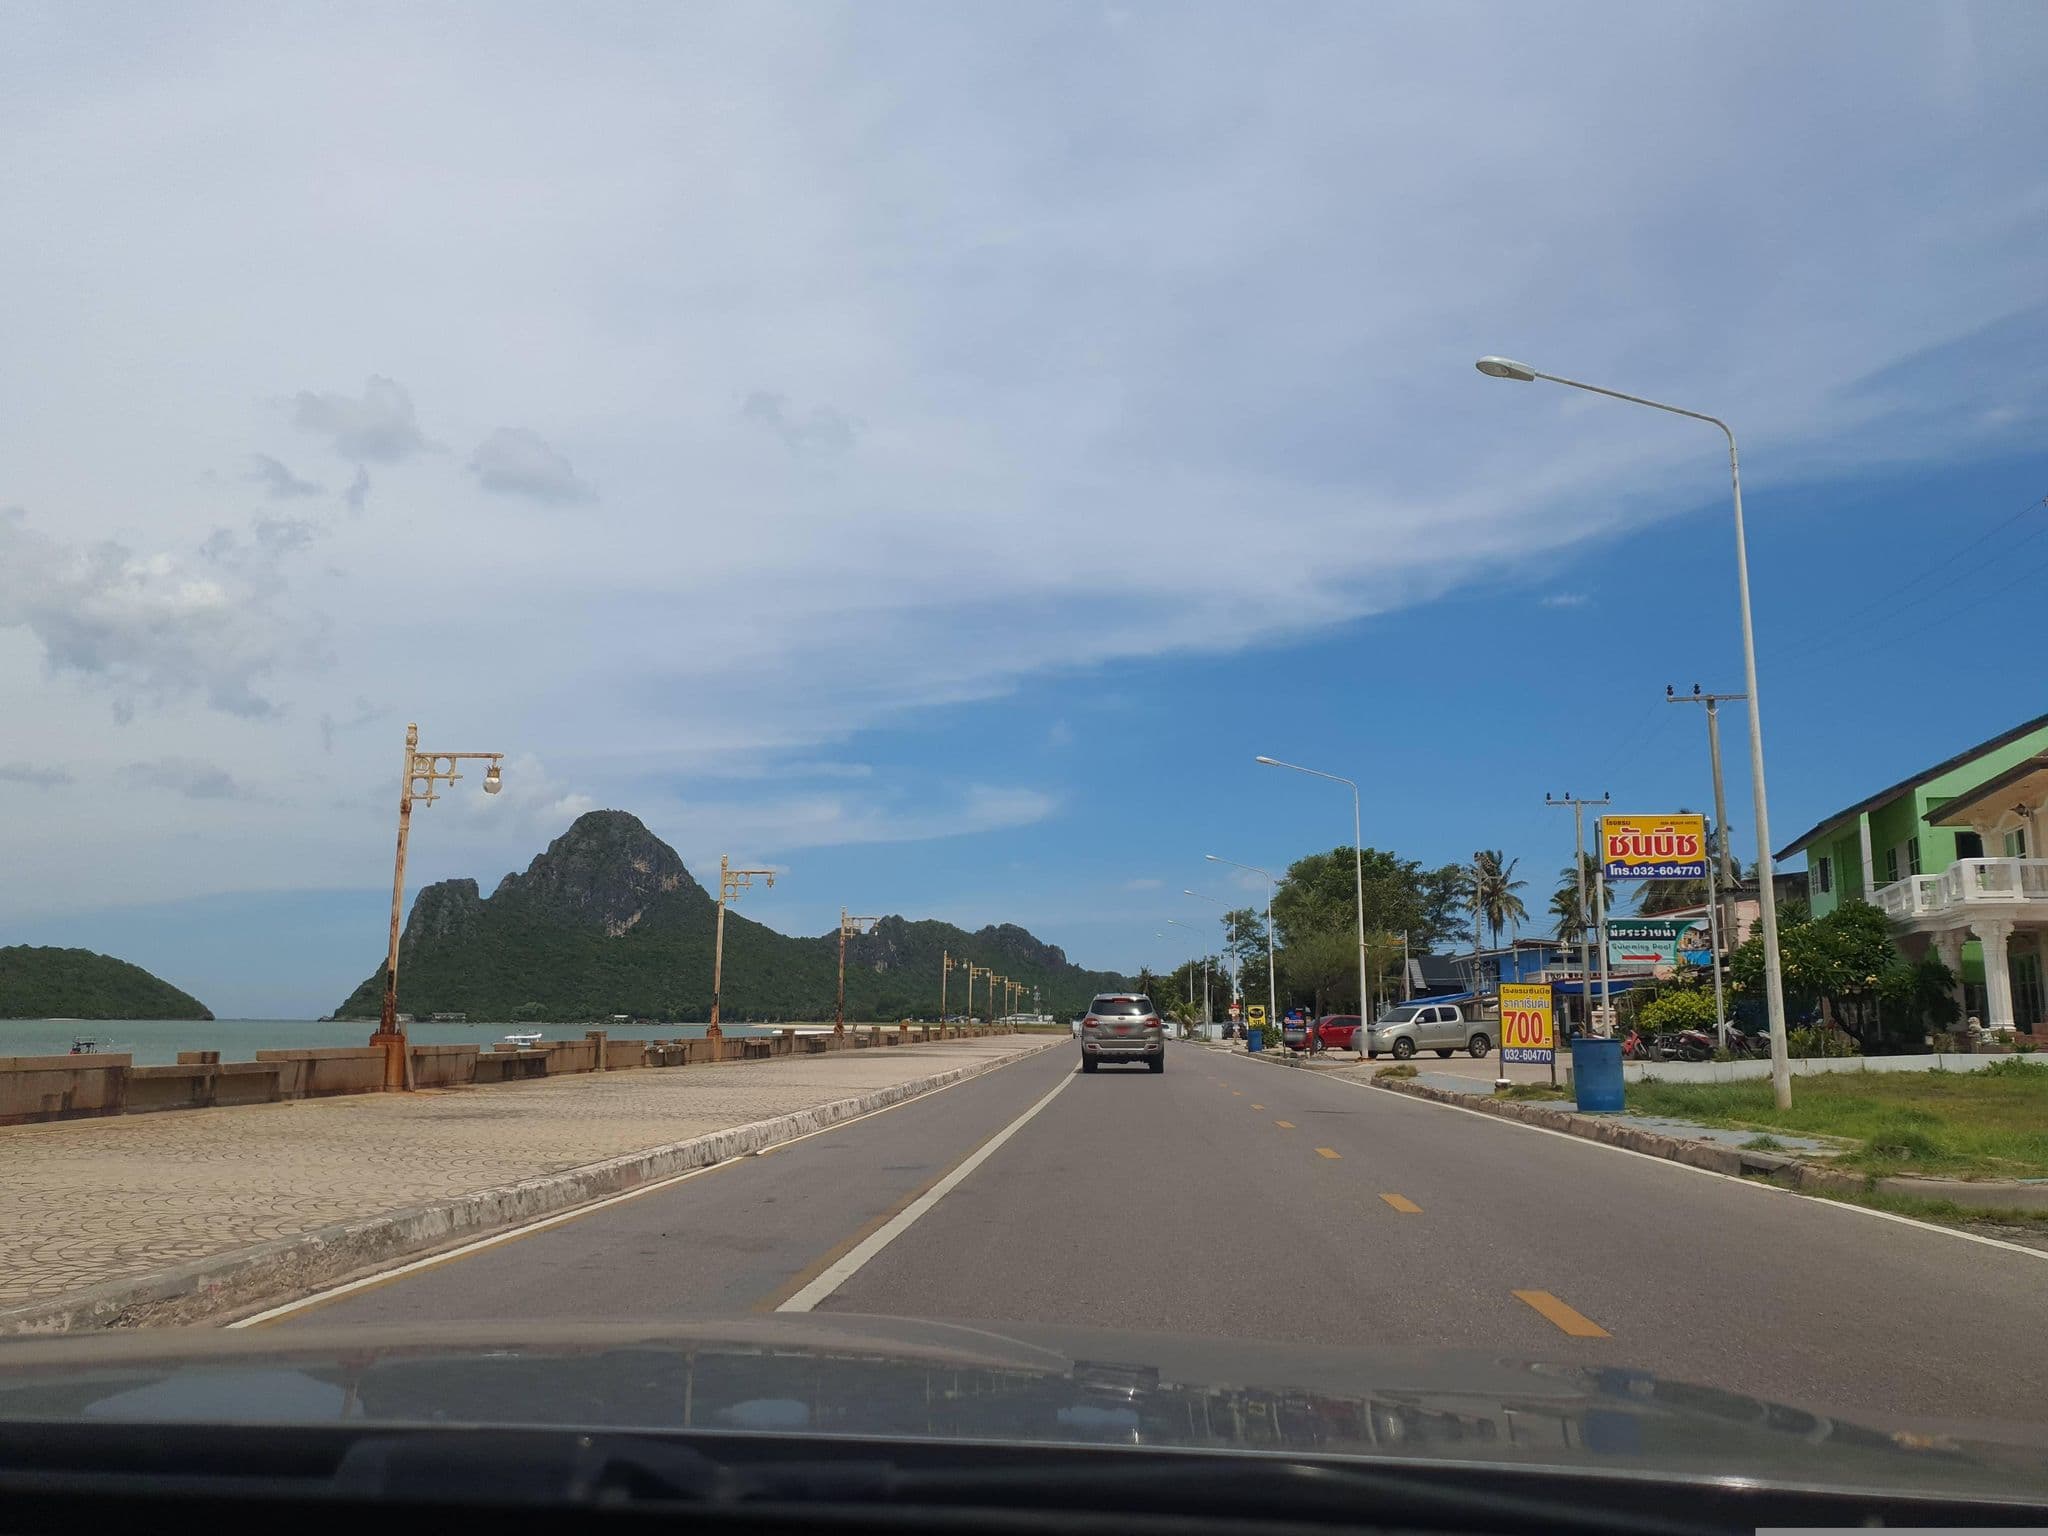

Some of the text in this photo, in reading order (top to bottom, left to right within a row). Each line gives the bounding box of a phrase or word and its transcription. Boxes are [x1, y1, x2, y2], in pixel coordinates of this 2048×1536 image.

[1610, 863, 1701, 876] โทร.032-604770
[1610, 921, 1676, 937] มีสระว่ายน้ำ
[1504, 1049, 1552, 1061] 032-604770
